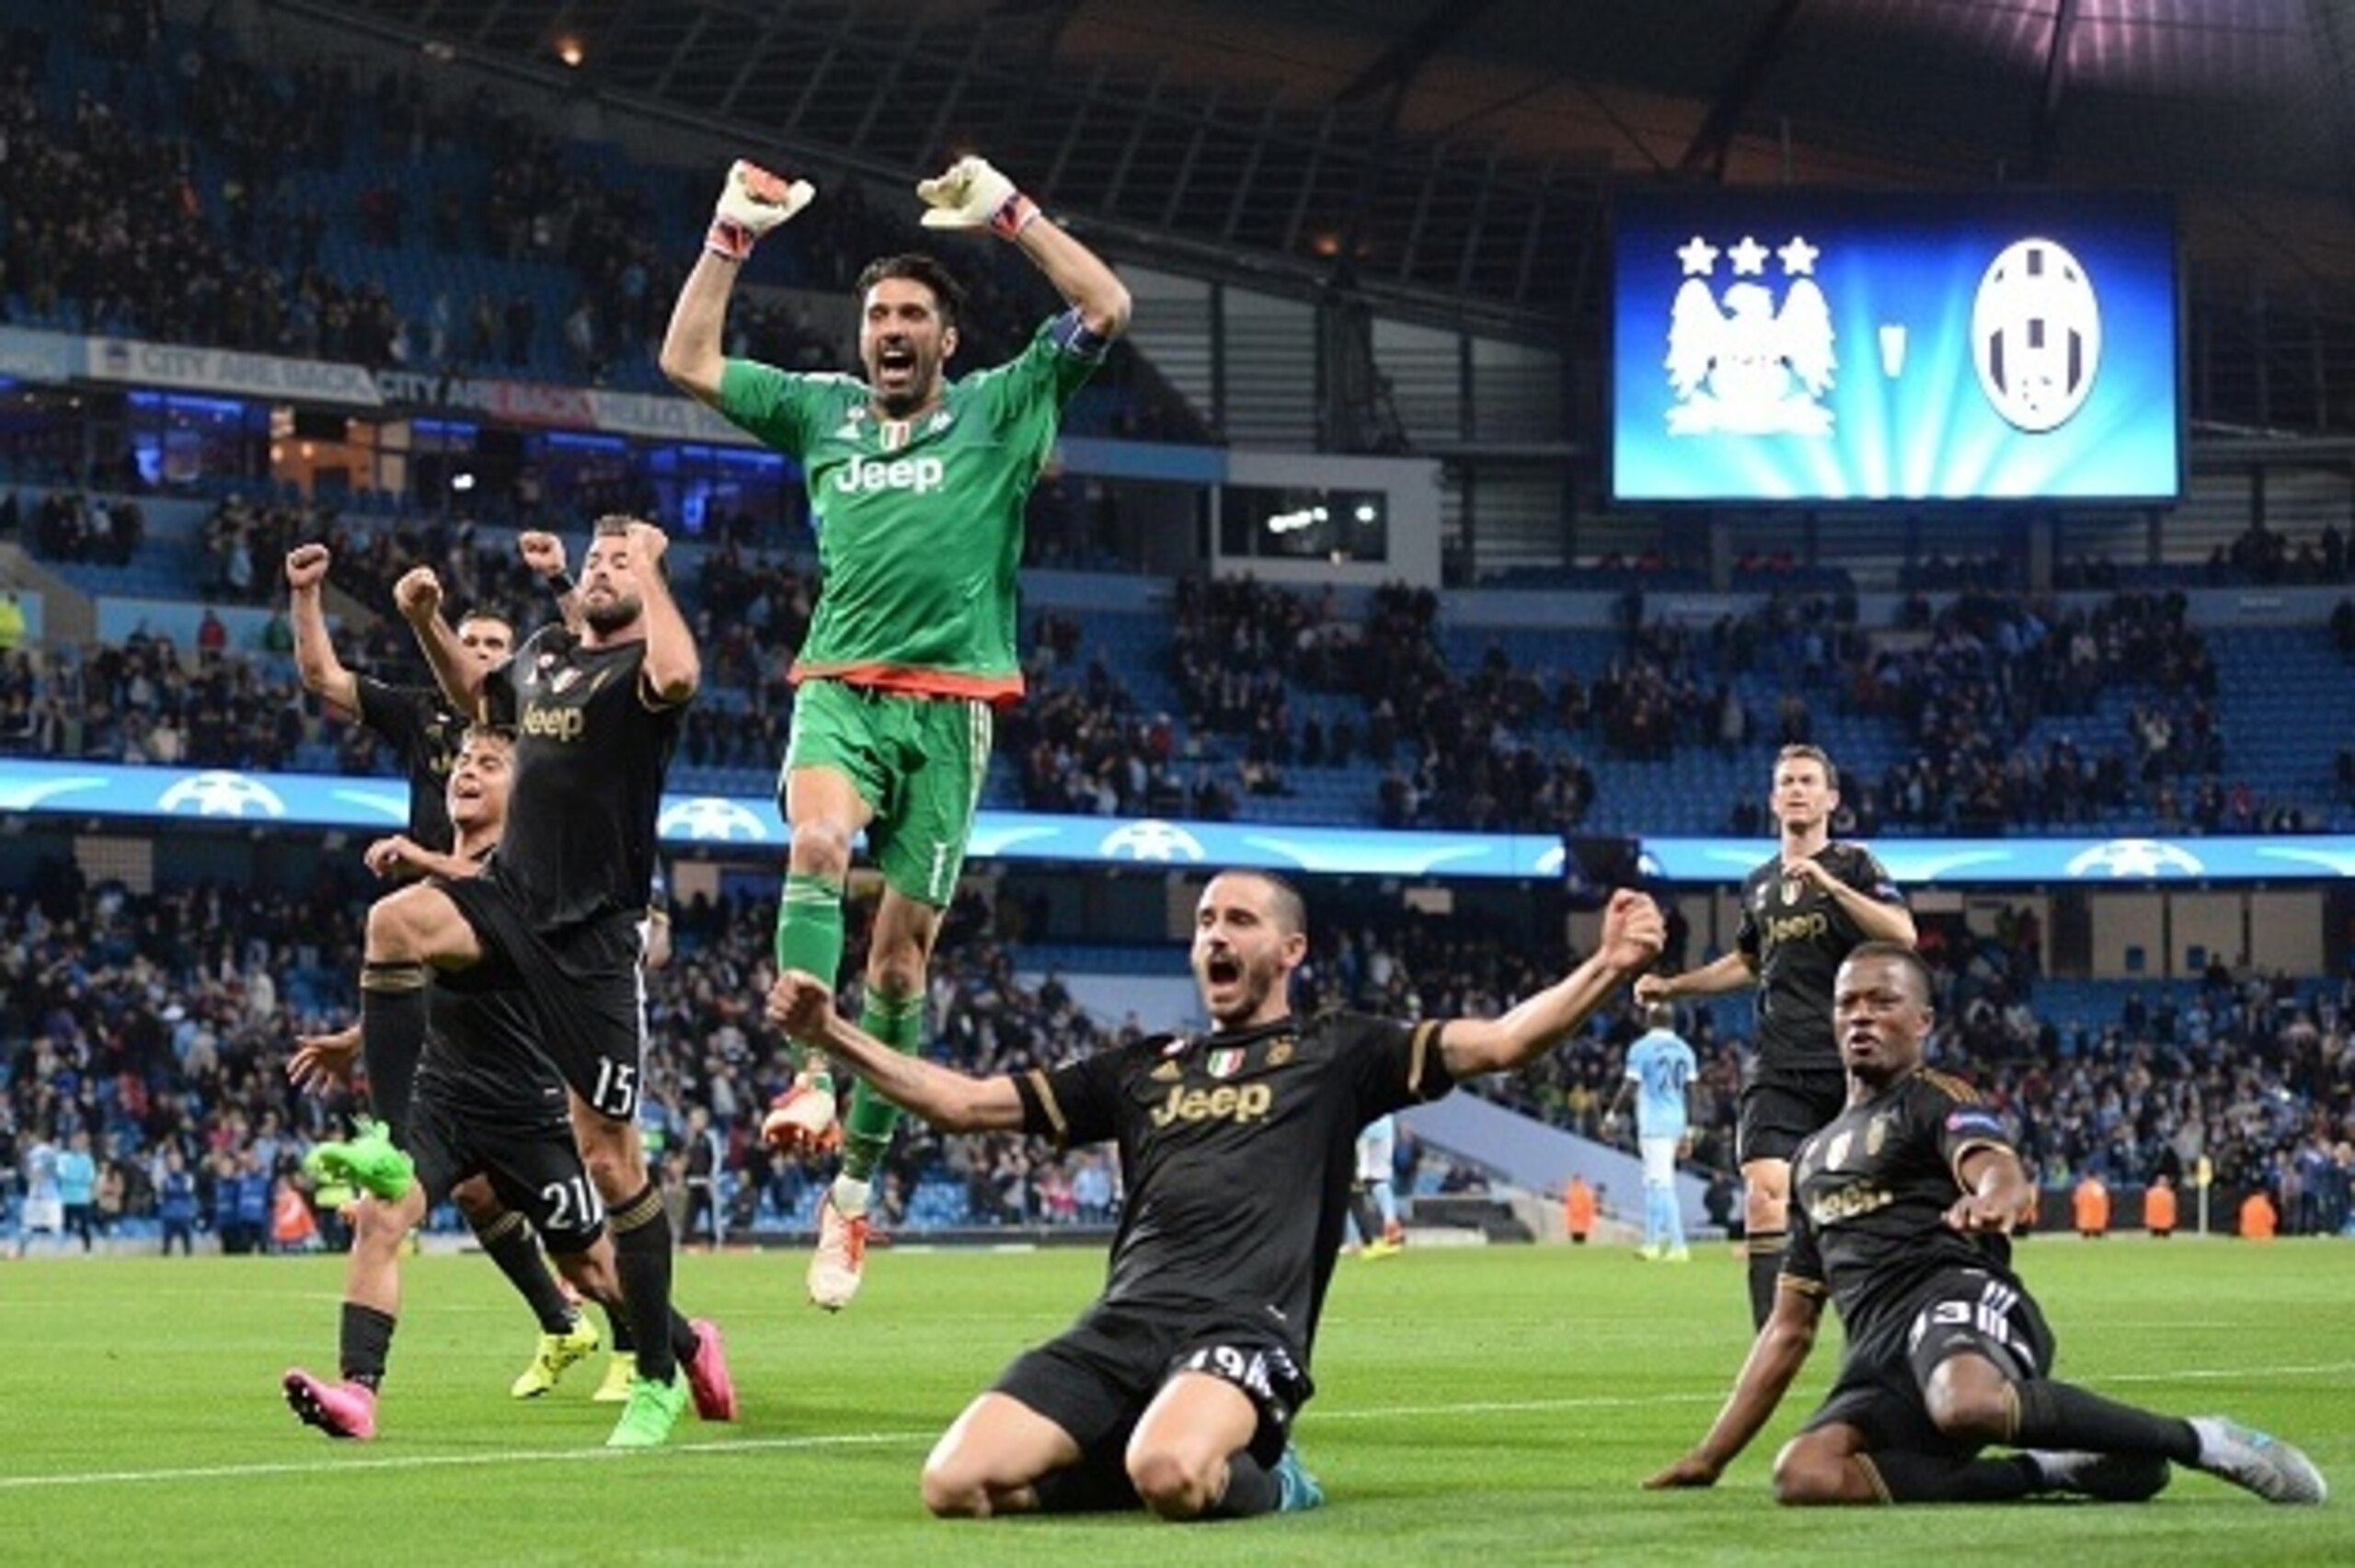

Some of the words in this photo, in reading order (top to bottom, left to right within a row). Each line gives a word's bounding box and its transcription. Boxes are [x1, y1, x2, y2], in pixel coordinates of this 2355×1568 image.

[140, 346, 206, 381] CITY
[376, 369, 441, 401] CITY
[834, 454, 943, 494] Jeep
[1762, 911, 1827, 947] Jeep
[592, 1056, 635, 1116] 15
[1151, 1083, 1271, 1127] Jeep
[542, 1175, 590, 1230] 21
